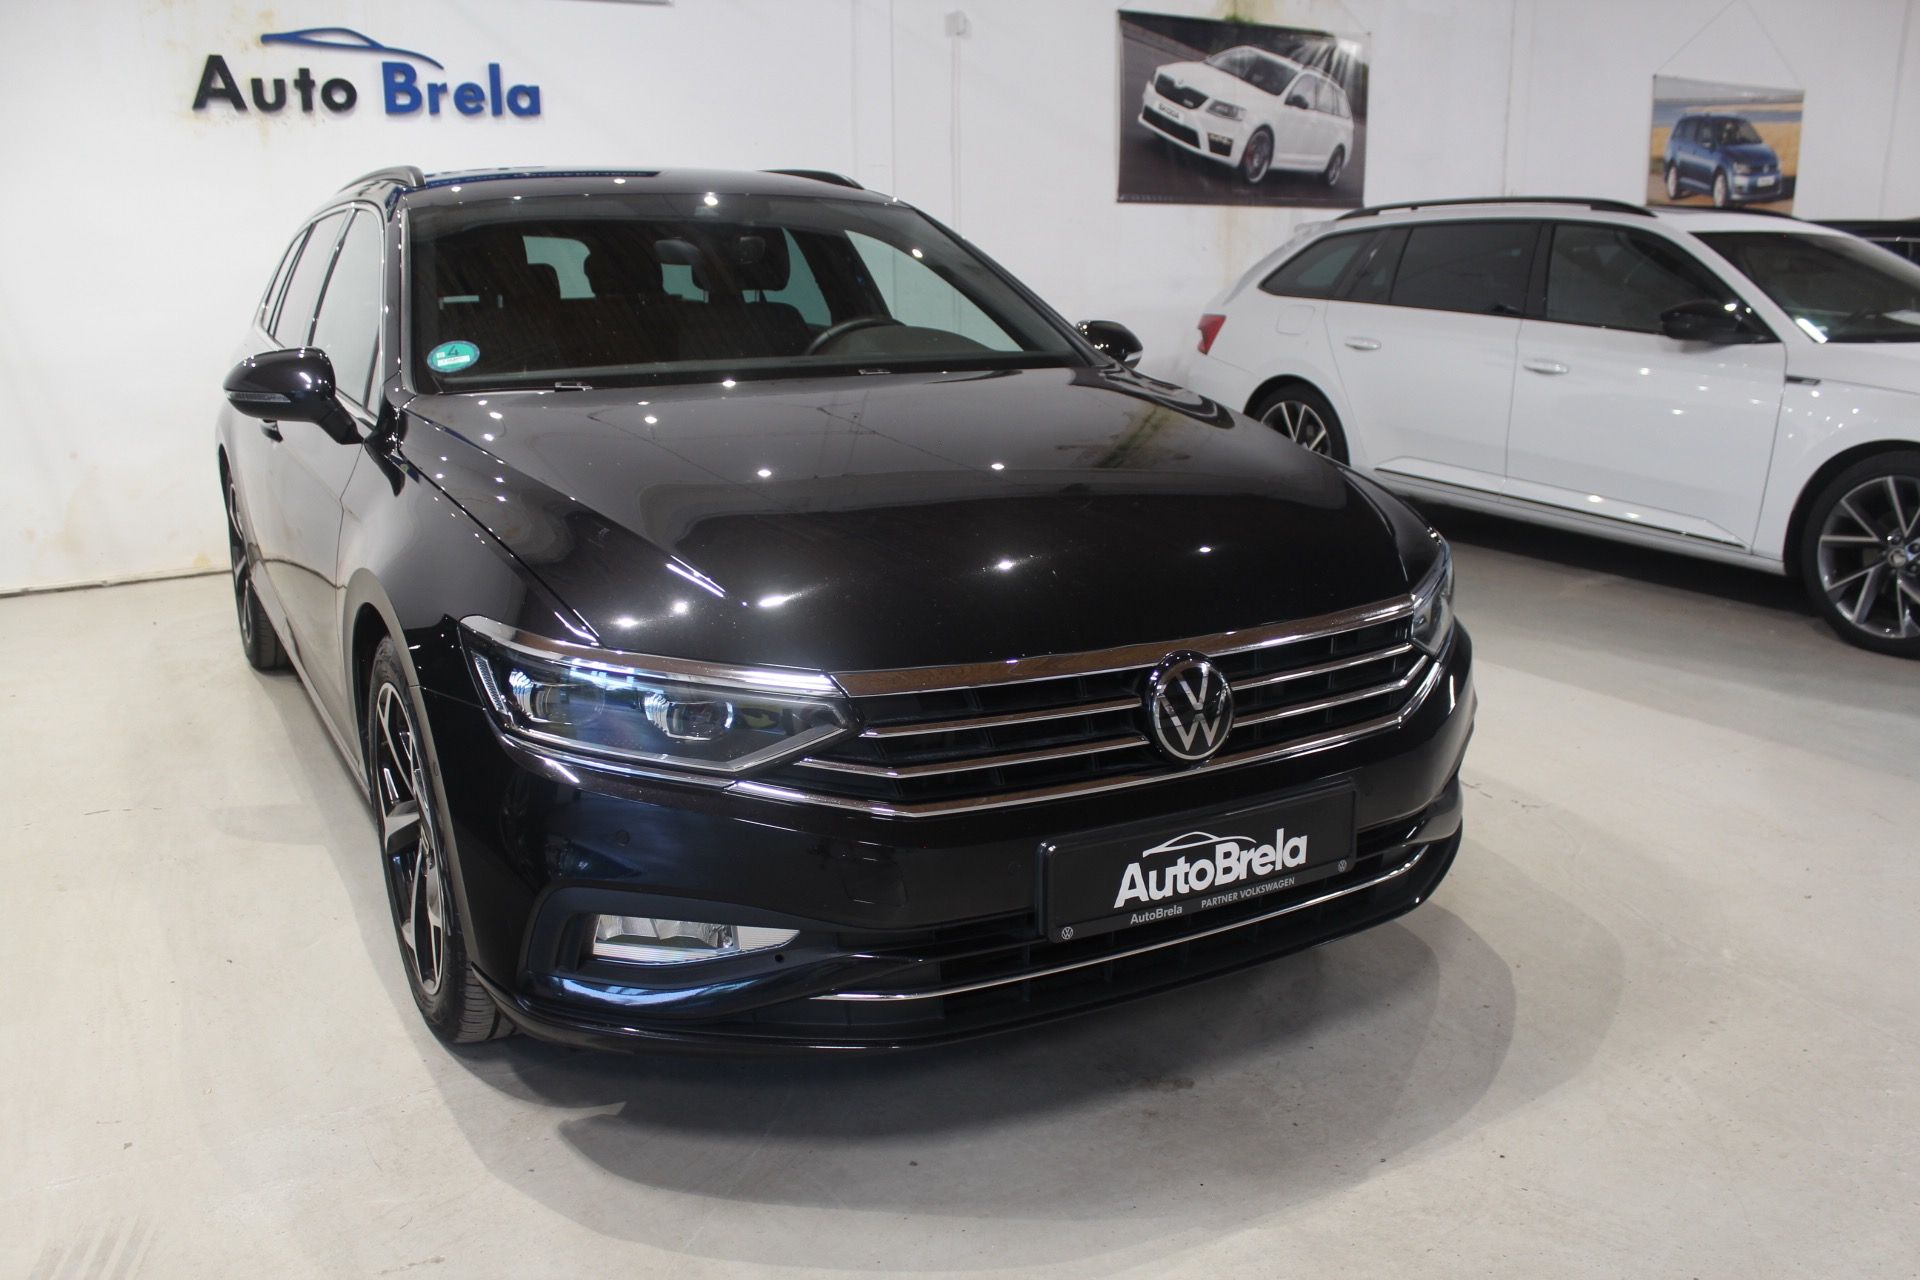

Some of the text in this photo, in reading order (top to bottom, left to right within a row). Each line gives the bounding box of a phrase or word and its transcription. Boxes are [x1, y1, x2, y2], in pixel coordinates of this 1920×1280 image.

[192, 54, 541, 117] Auto Brela
[447, 345, 459, 357] 4
[1114, 828, 1307, 908] AutoBrela
[1201, 877, 1295, 909] PARTNER VOLKSWAGEN
[1130, 905, 1183, 925] AutoBrela
